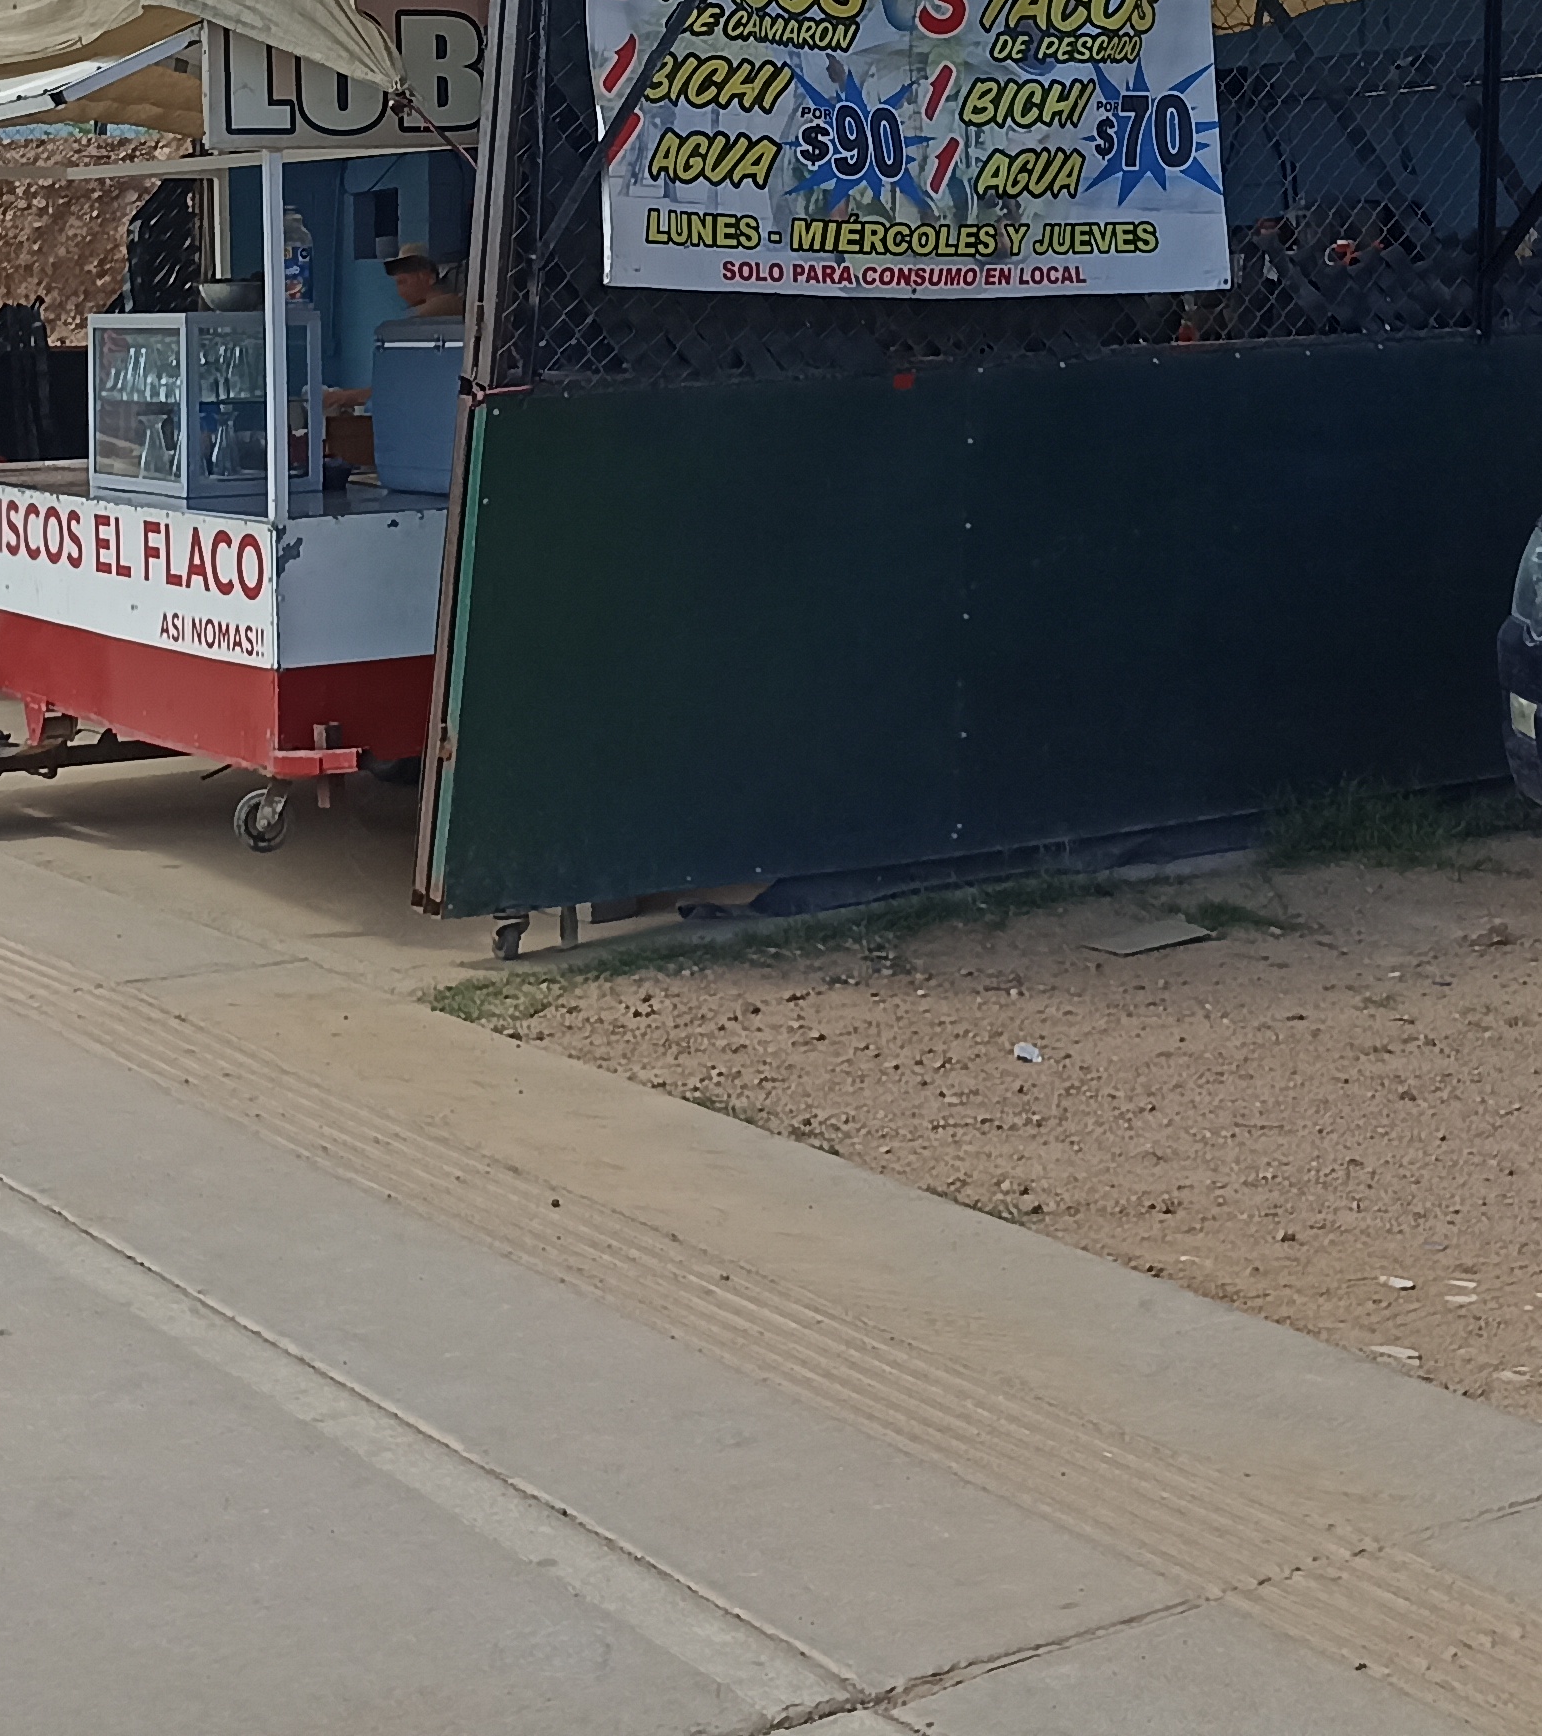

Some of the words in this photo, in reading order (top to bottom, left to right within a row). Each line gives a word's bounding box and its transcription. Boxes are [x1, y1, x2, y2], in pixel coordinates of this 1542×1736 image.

[725, 9, 860, 52] CAMARON
[990, 34, 1032, 61] DE
[1036, 32, 1143, 64] PESCADO
[601, 34, 637, 93] 1
[801, 107, 833, 120] POR
[924, 61, 957, 122] 1
[960, 77, 1096, 129] BICHI
[1096, 100, 1120, 113] POR
[797, 102, 906, 182] $90
[1093, 91, 1196, 170] $70
[649, 128, 782, 190] AGUA
[927, 135, 961, 195] 1
[975, 147, 1086, 200] AGUA
[645, 209, 760, 248] LUNES
[790, 216, 998, 257] MIÉRCOLES
[1005, 222, 1028, 254] Y
[1032, 220, 1159, 254] JUEVES
[722, 260, 784, 283] SOLO
[792, 263, 854, 286] PARA
[861, 265, 978, 288] CONSUMO
[984, 266, 1011, 286] EN
[1019, 265, 1087, 285] LOCAL
[94, 513, 132, 579] EL
[143, 519, 265, 601] FLACO
[160, 612, 185, 642] ASI
[191, 616, 266, 658] NOMAS!!
